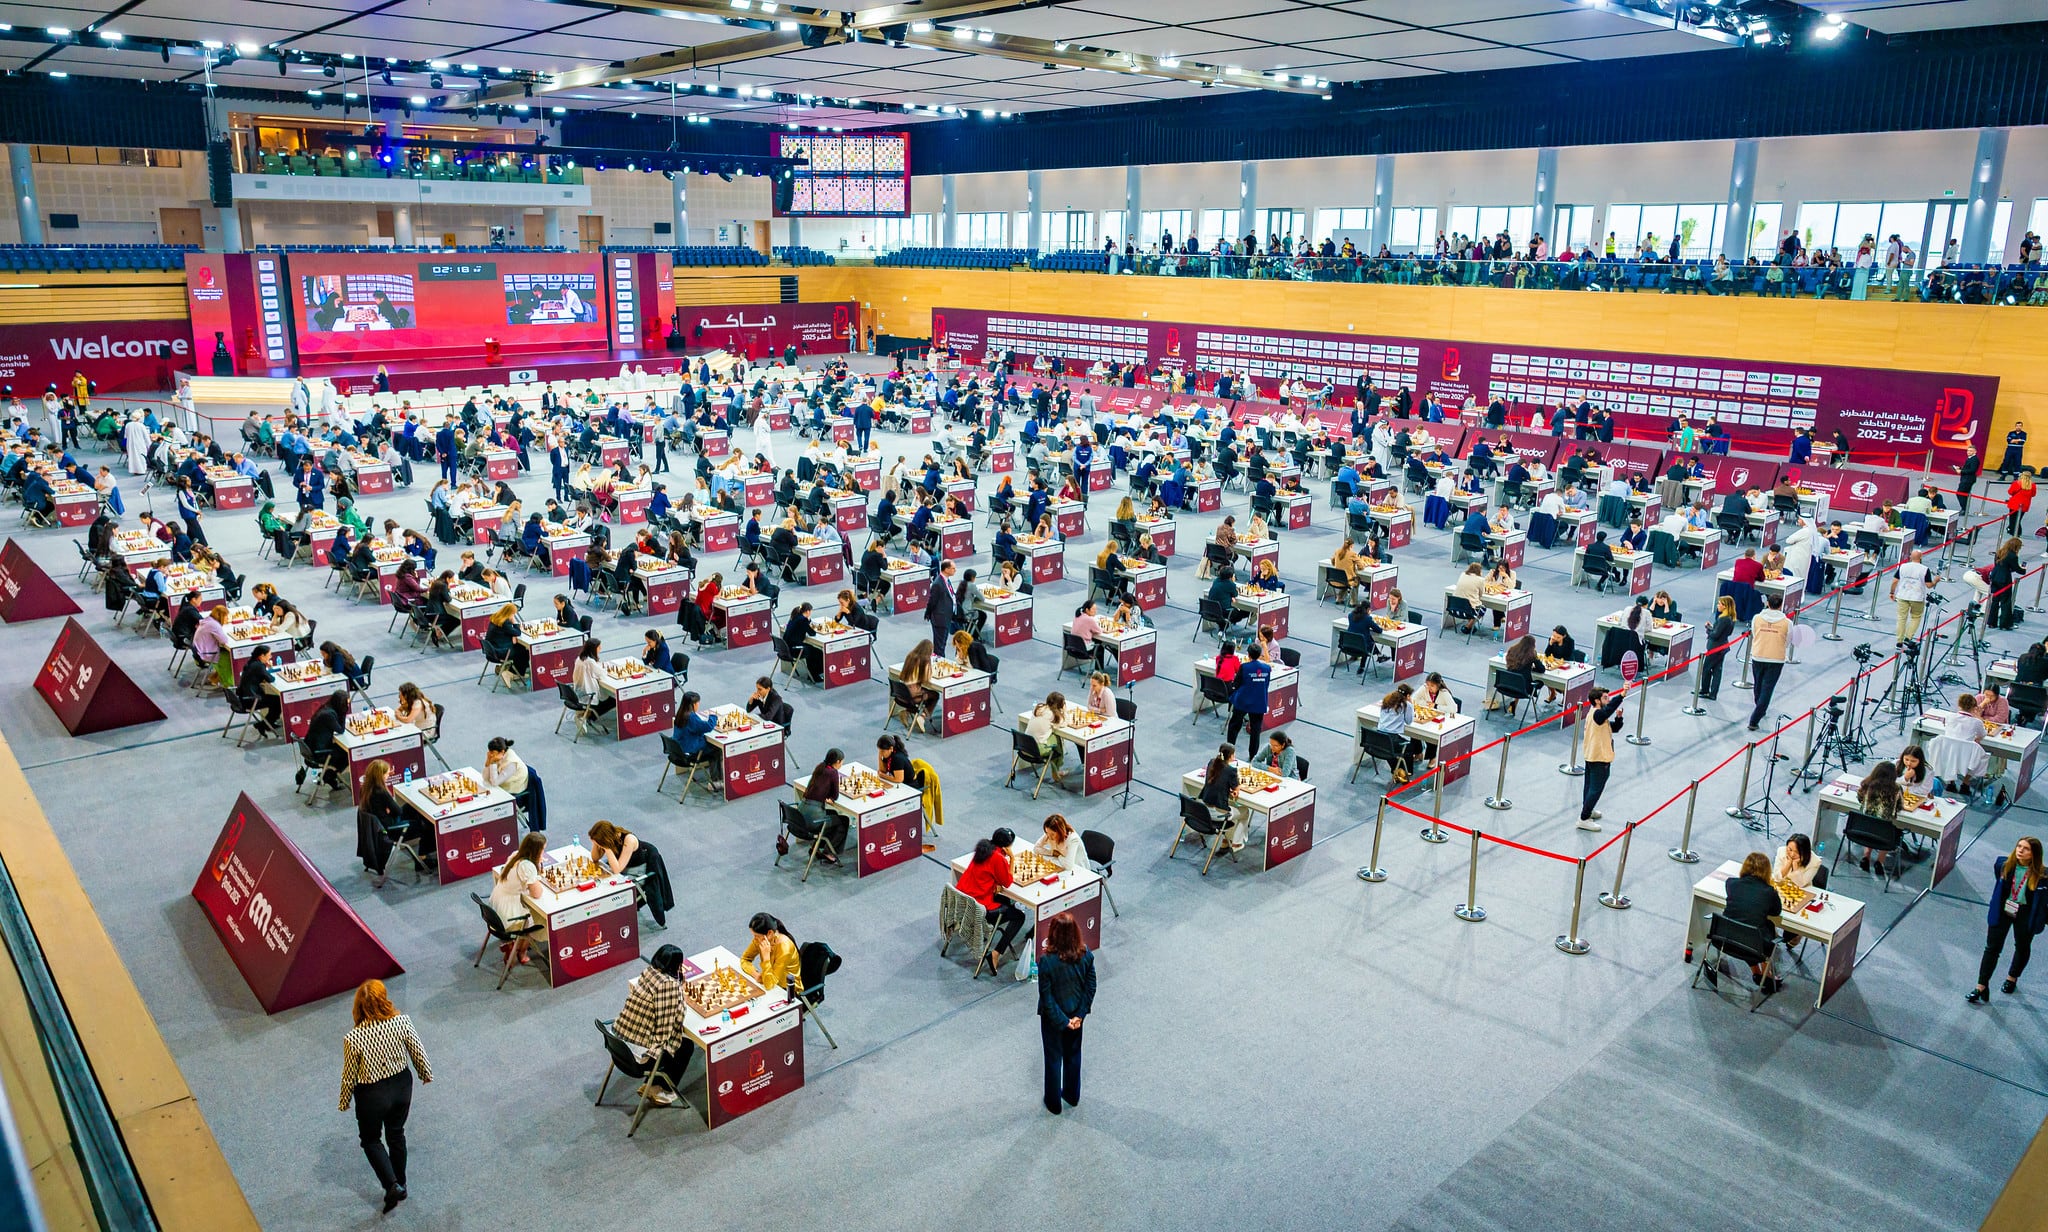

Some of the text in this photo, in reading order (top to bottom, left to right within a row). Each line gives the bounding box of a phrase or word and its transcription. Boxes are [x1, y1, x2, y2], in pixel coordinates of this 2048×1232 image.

[50, 335, 188, 360] Welcome
[1840, 409, 1874, 418] للشطرنج
[1900, 414, 1926, 424] بطولة
[1857, 428, 1922, 444] قطر 2025
[1512, 447, 1545, 457] oredoo
[221, 876, 239, 904] Qatar 2025
[745, 1080, 770, 1095] Qatar 2025
